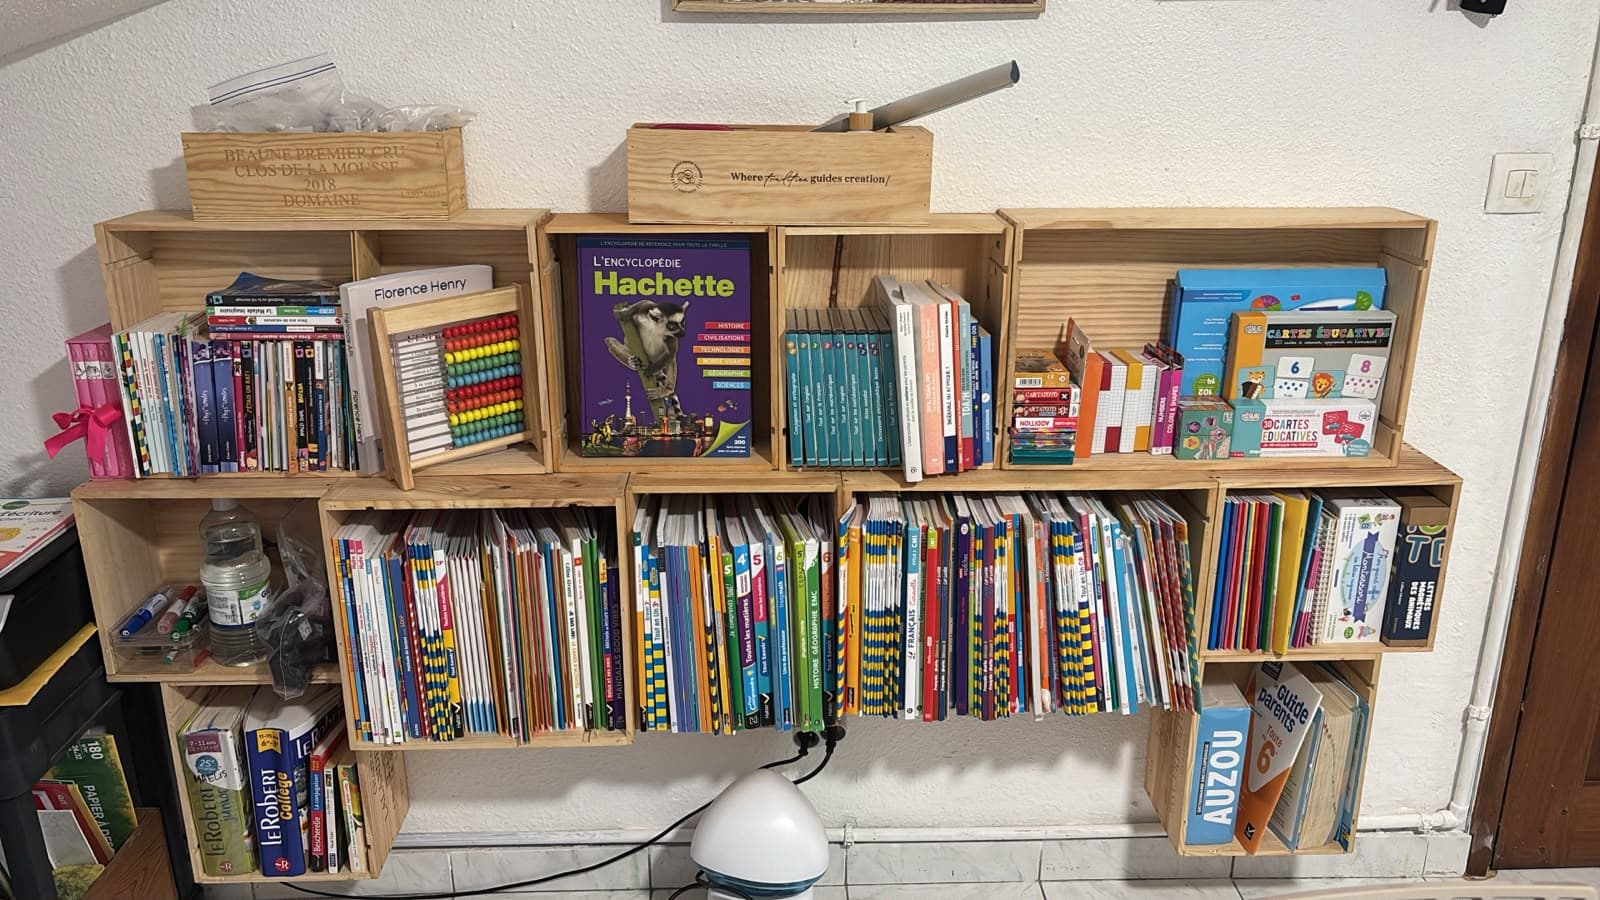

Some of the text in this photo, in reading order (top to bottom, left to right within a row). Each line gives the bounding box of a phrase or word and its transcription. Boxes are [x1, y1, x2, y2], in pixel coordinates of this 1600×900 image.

[225, 145, 406, 161] BEAUNE PREMIER CRU
[234, 160, 400, 177] CLOS DE LA MOUSSE
[730, 172, 763, 182] Where
[809, 173, 842, 184] guides
[303, 178, 337, 192] 2018
[284, 193, 360, 208] DOMAINE
[593, 255, 682, 269] L'ENCYCLOPÉDIE
[374, 278, 468, 301] Florence Henry
[594, 270, 736, 297] Hachette
[1266, 328, 1312, 339] CARTES
[1315, 325, 1391, 339] ÉDUCATIVES
[1291, 361, 1301, 374] 6
[1360, 359, 1372, 373] 8
[351, 390, 360, 422] Florence
[961, 391, 971, 416] TDA/H
[1025, 391, 1060, 399] CARTATOTO
[1262, 431, 1318, 442] EDUCATIVES
[1273, 419, 1310, 431] CARTES
[1077, 556, 1084, 565] CP
[1078, 565, 1085, 573] Un
[1079, 574, 1086, 582] en
[1356, 551, 1374, 604] Montessori
[439, 584, 447, 604] matières
[1404, 581, 1419, 629] DES ANIMAUX
[1412, 581, 1427, 630] MAGNÉTIQUES
[1424, 581, 1436, 611] LETTRES
[652, 608, 661, 641] Tout en Un
[726, 599, 735, 629] comprends
[741, 598, 750, 628] matières
[743, 629, 751, 639] les
[810, 591, 820, 689] HISTOIRE GÉOGRAPHIE EMC
[907, 609, 917, 649] FRANÇAIS
[611, 603, 623, 699] MANDALAS GOOD VIBES
[744, 640, 753, 664] Toutes
[1257, 687, 1296, 733] parents
[1277, 684, 1309, 725] Guide
[87, 740, 104, 760] 180
[1203, 730, 1243, 825] AUZOU
[83, 784, 106, 820] PAPIER
[255, 767, 282, 846] LE ROBERT
[277, 770, 293, 821] Collège
[313, 803, 320, 811] La
[199, 787, 220, 844] ROBERT
[312, 816, 322, 853] Bescherelle
